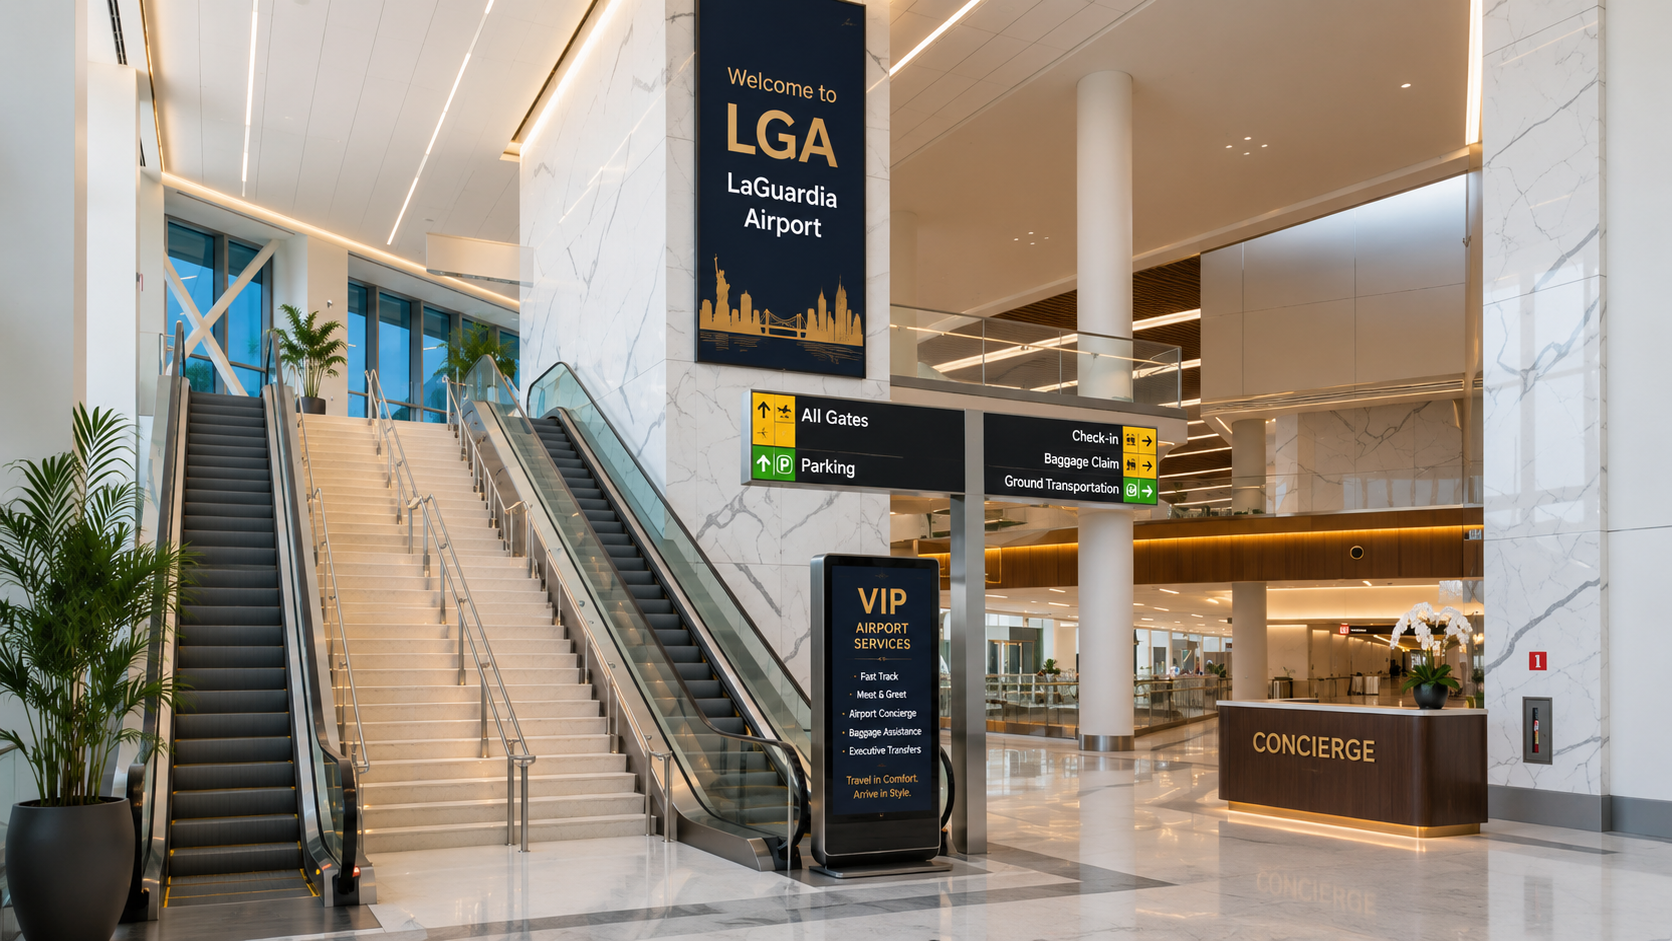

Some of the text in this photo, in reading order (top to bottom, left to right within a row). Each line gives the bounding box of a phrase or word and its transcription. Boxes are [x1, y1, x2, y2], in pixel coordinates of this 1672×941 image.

[727, 67, 837, 103] Welcome to
[728, 103, 838, 168] LGA
[728, 172, 838, 208] LaGuardia
[744, 207, 823, 238] Airport
[802, 408, 868, 427] All Gates
[1073, 430, 1118, 444] Check-in
[802, 458, 855, 478] Parking
[1045, 453, 1119, 469] Baggage Claim
[1005, 475, 1119, 494] Ground Transportation
[858, 588, 907, 615] VIP
[856, 622, 909, 634] AIRPORT
[855, 637, 911, 650] SERVICES
[1534, 654, 1542, 669] 1
[861, 672, 899, 681] Fast Track
[857, 691, 877, 700] Meet
[886, 690, 907, 699] Greet
[849, 709, 917, 721] Airport Concierge
[849, 728, 922, 740] Baggage Assistance
[850, 745, 922, 756] Executive Transfers
[1253, 732, 1375, 762] CONCIERGE
[847, 776, 872, 786] Travel
[874, 776, 882, 784] in
[854, 789, 912, 800] Arrive in Style.
